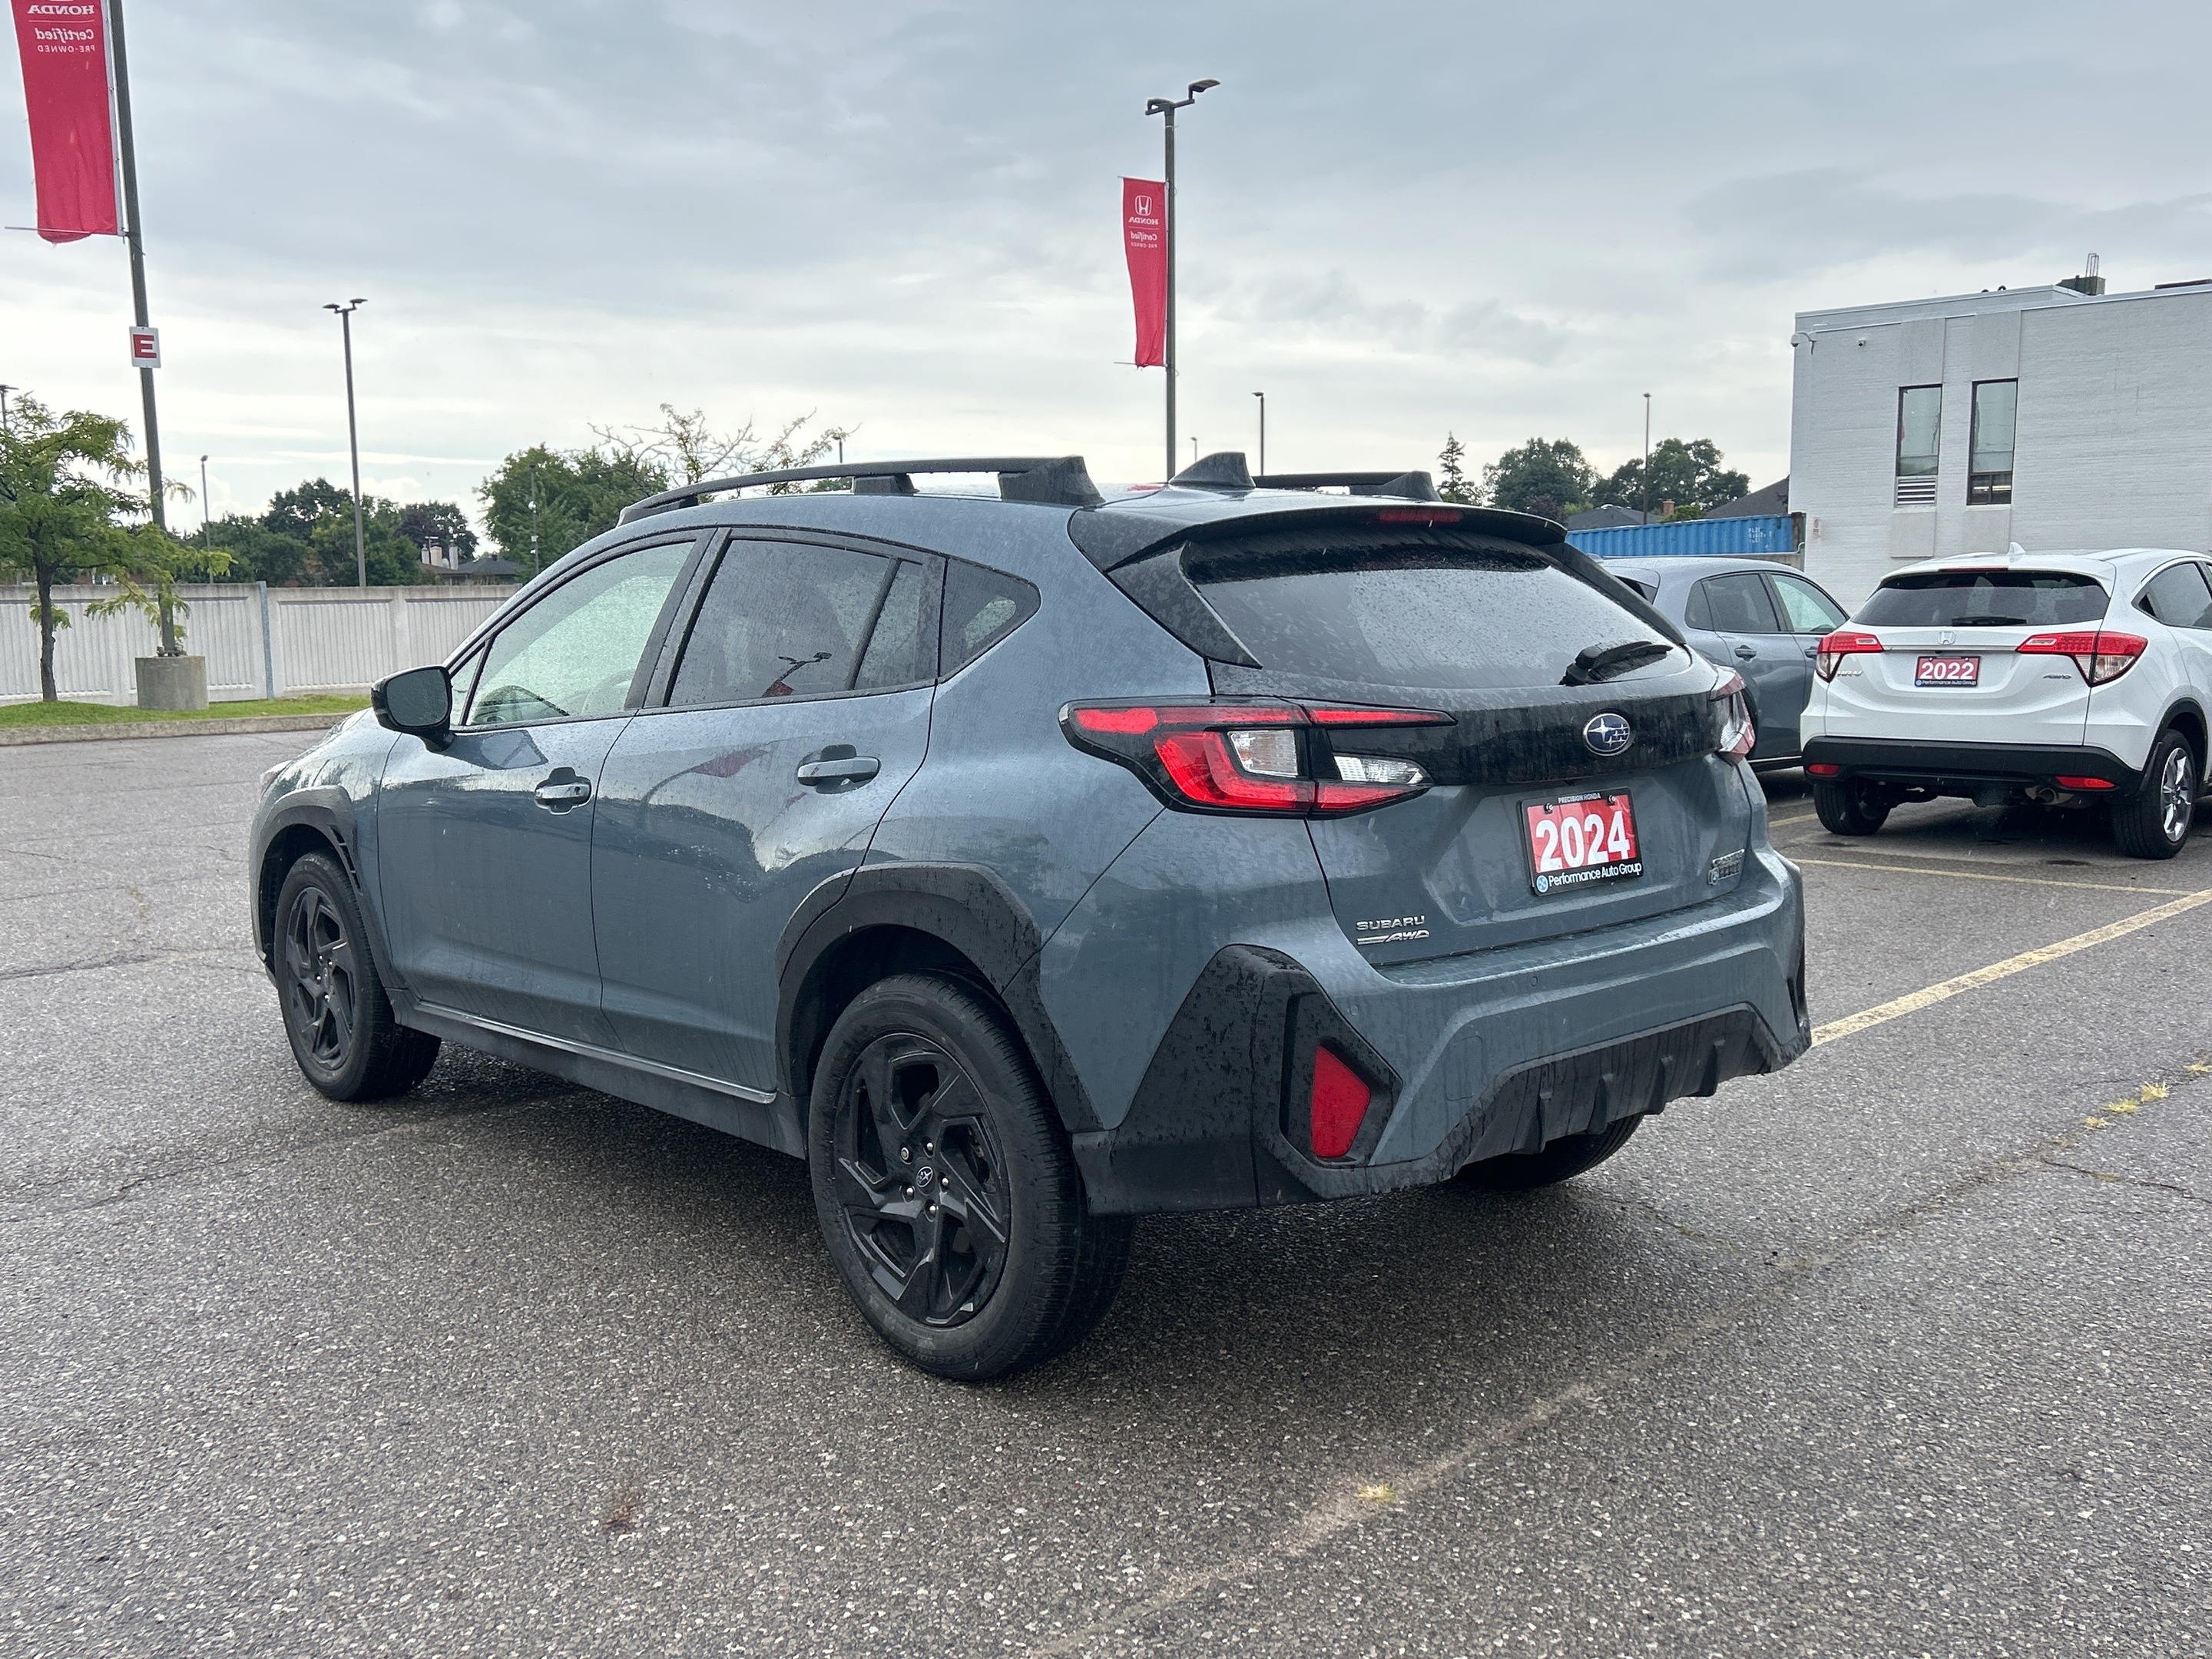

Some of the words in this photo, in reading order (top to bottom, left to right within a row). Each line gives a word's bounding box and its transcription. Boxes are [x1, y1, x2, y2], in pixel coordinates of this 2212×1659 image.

[132, 334, 157, 359] E
[1919, 661, 1975, 680] 2022
[1535, 810, 1631, 873] 2024
[1548, 869, 1601, 887] Performance
[1601, 866, 1619, 878] Auto
[1618, 862, 1642, 876] Group
[1356, 915, 1426, 931] SUBARU
[1385, 929, 1430, 942] AWD
